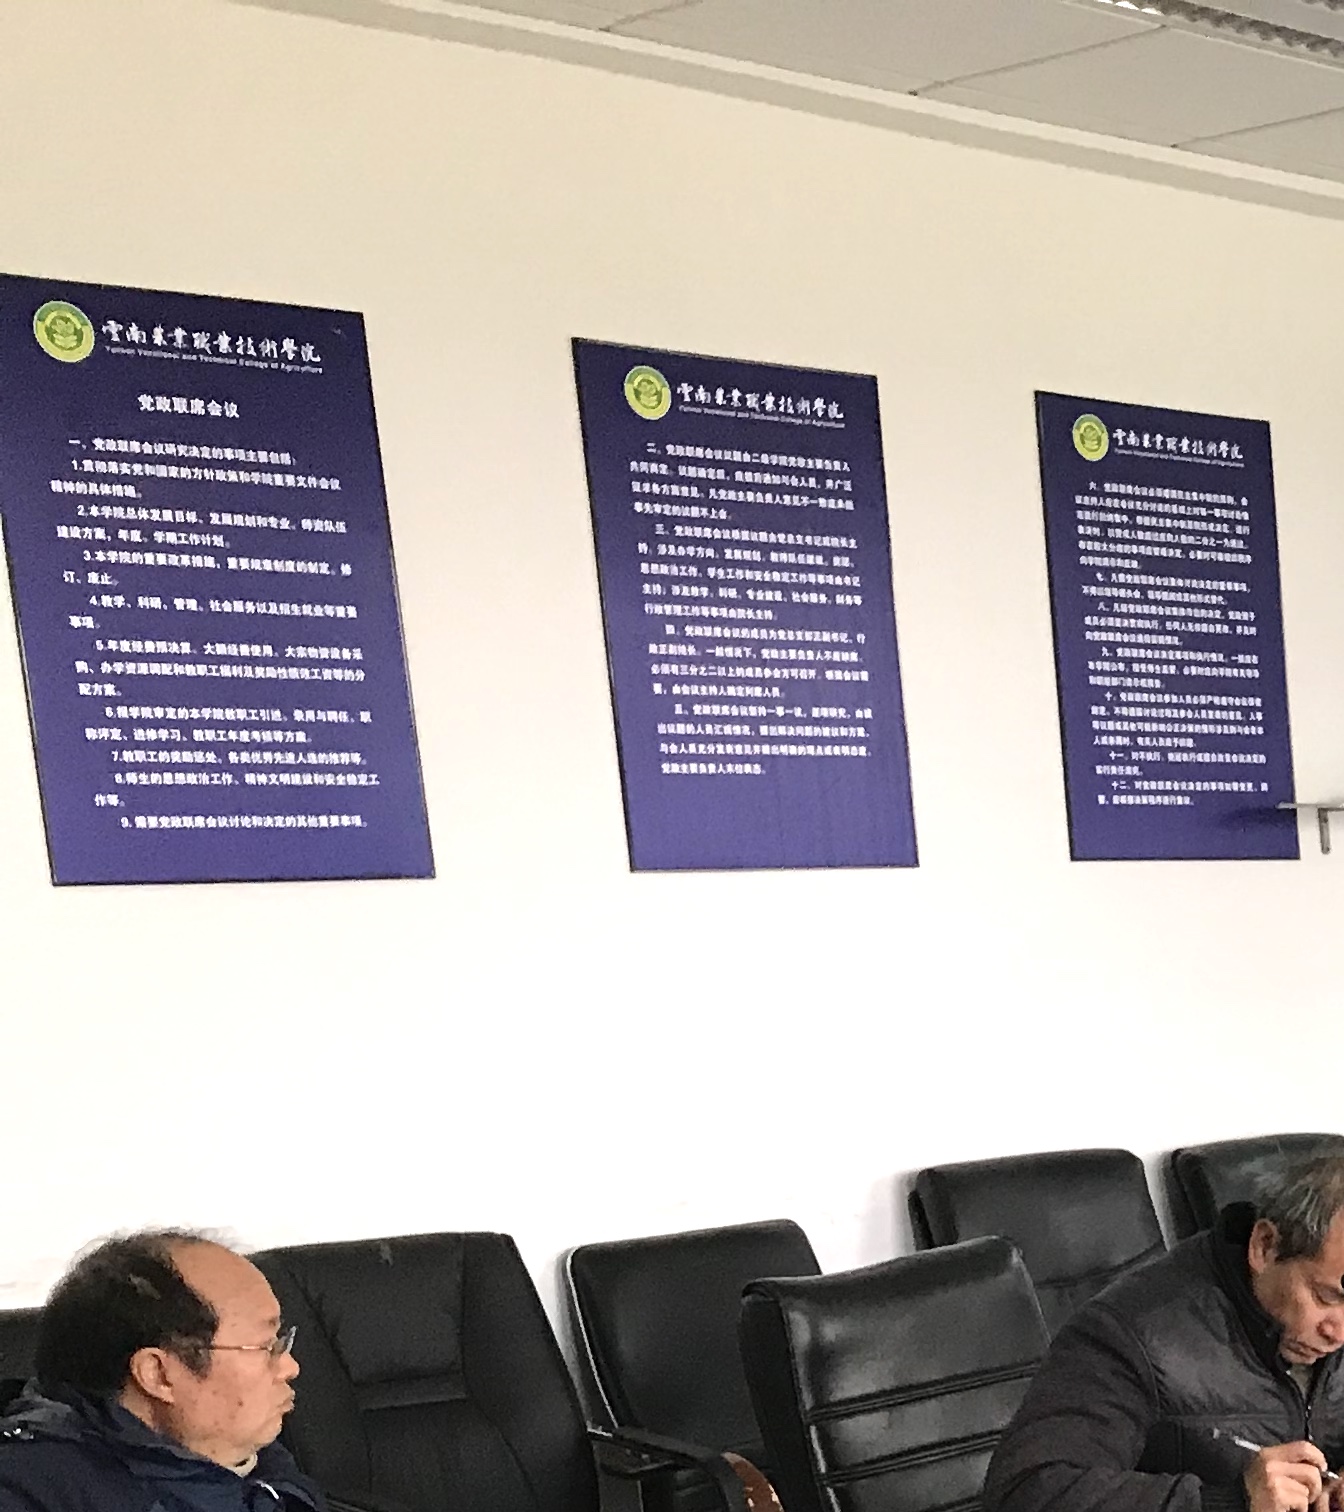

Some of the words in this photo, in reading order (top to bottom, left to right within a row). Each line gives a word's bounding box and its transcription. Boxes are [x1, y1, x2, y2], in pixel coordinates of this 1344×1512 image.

[138, 394, 240, 418] 党政联席会议
